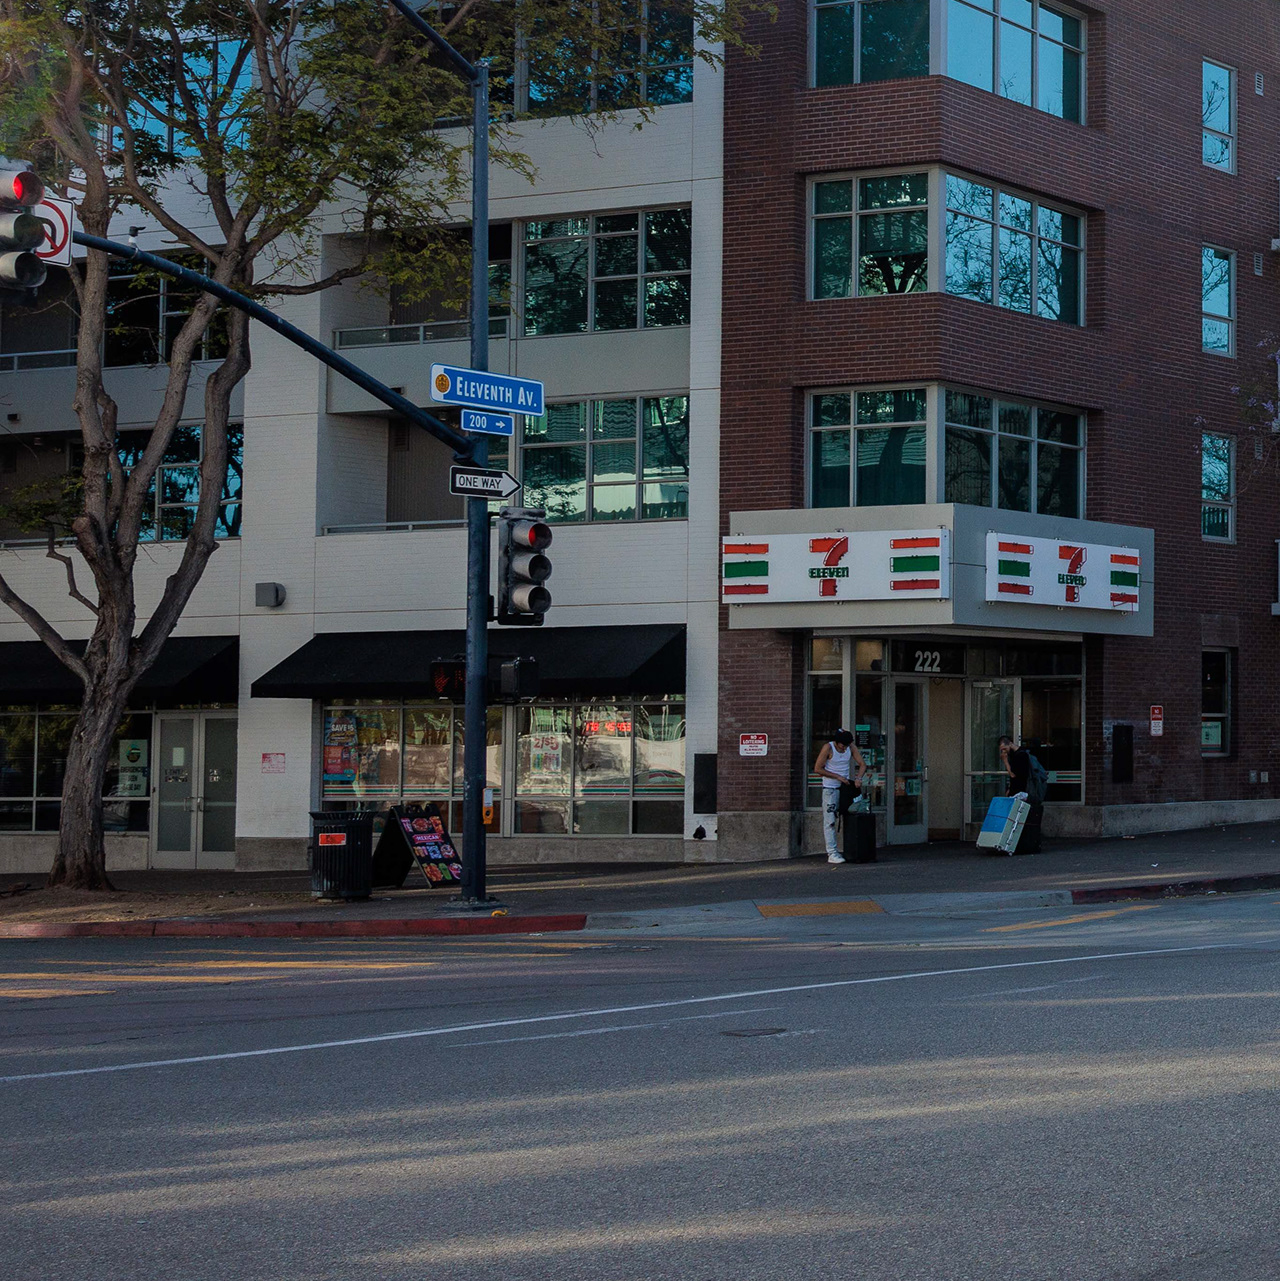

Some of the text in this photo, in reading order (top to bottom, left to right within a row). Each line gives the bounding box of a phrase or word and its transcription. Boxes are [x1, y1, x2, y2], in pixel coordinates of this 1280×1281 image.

[456, 376, 513, 403] ELEVENTH
[469, 414, 487, 428] 200
[458, 475, 502, 489] ONE WAY
[808, 536, 849, 596] 7 ELEVEN
[1058, 545, 1086, 602] 7
[914, 650, 941, 673] 222
